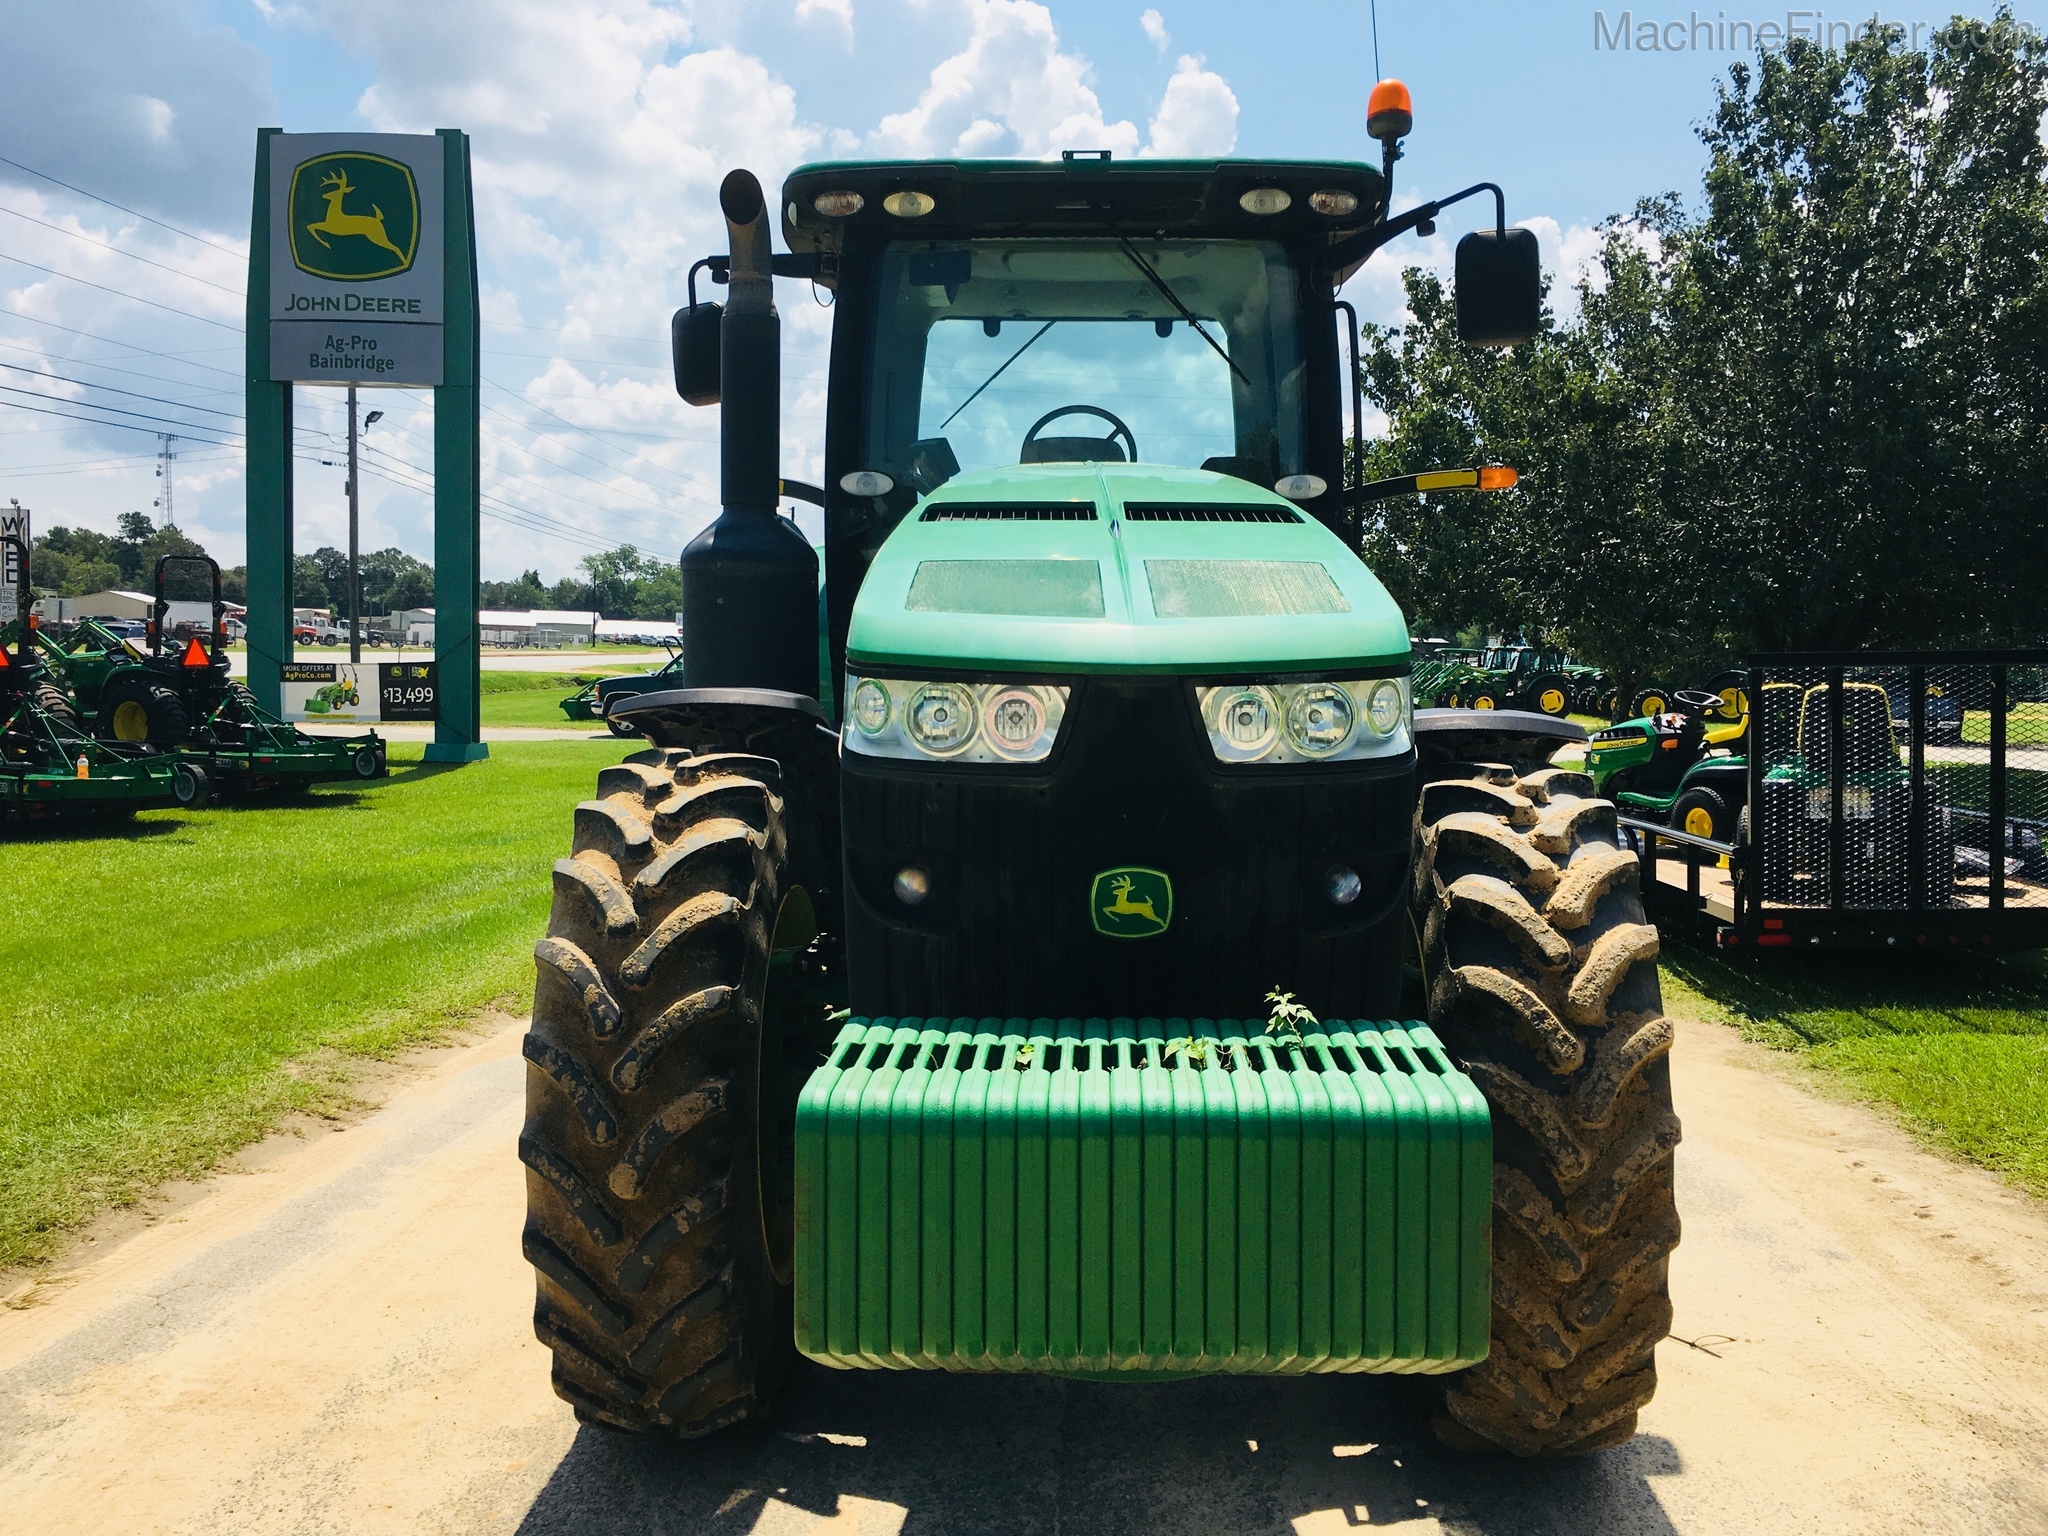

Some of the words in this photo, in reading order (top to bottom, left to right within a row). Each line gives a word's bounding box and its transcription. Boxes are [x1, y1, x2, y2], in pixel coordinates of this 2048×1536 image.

[284, 293, 340, 312] JOHN
[344, 293, 421, 314] DEERE
[324, 334, 378, 353] Ag-Pro
[309, 353, 395, 373] Bainbridge
[285, 672, 331, 681] AgProCo.com
[383, 687, 434, 705] $13,499
